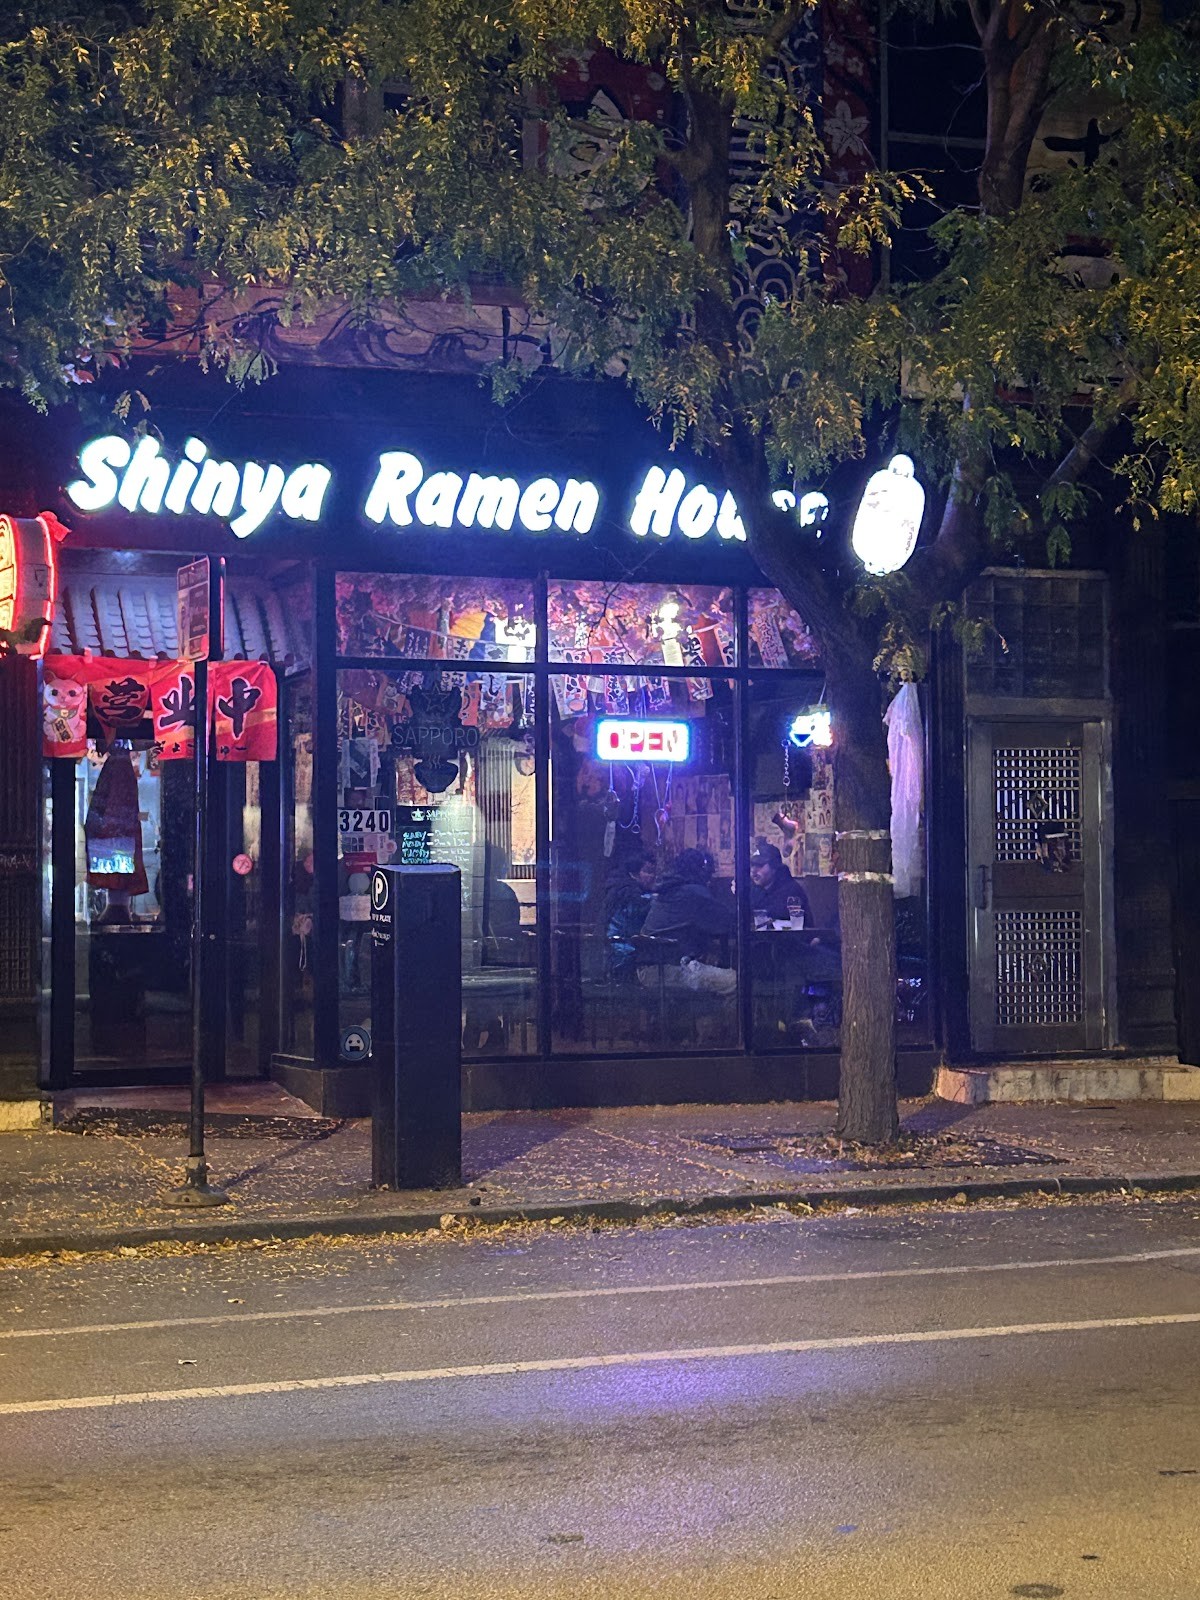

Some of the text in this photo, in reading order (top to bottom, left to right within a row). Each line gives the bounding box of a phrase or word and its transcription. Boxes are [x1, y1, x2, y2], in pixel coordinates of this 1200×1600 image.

[68, 435, 331, 538] Shinya
[365, 452, 599, 533] Ramen
[393, 725, 478, 747] SAPPORO
[604, 726, 684, 755] OPEN
[339, 811, 389, 832] 3240
[375, 877, 384, 903] P
